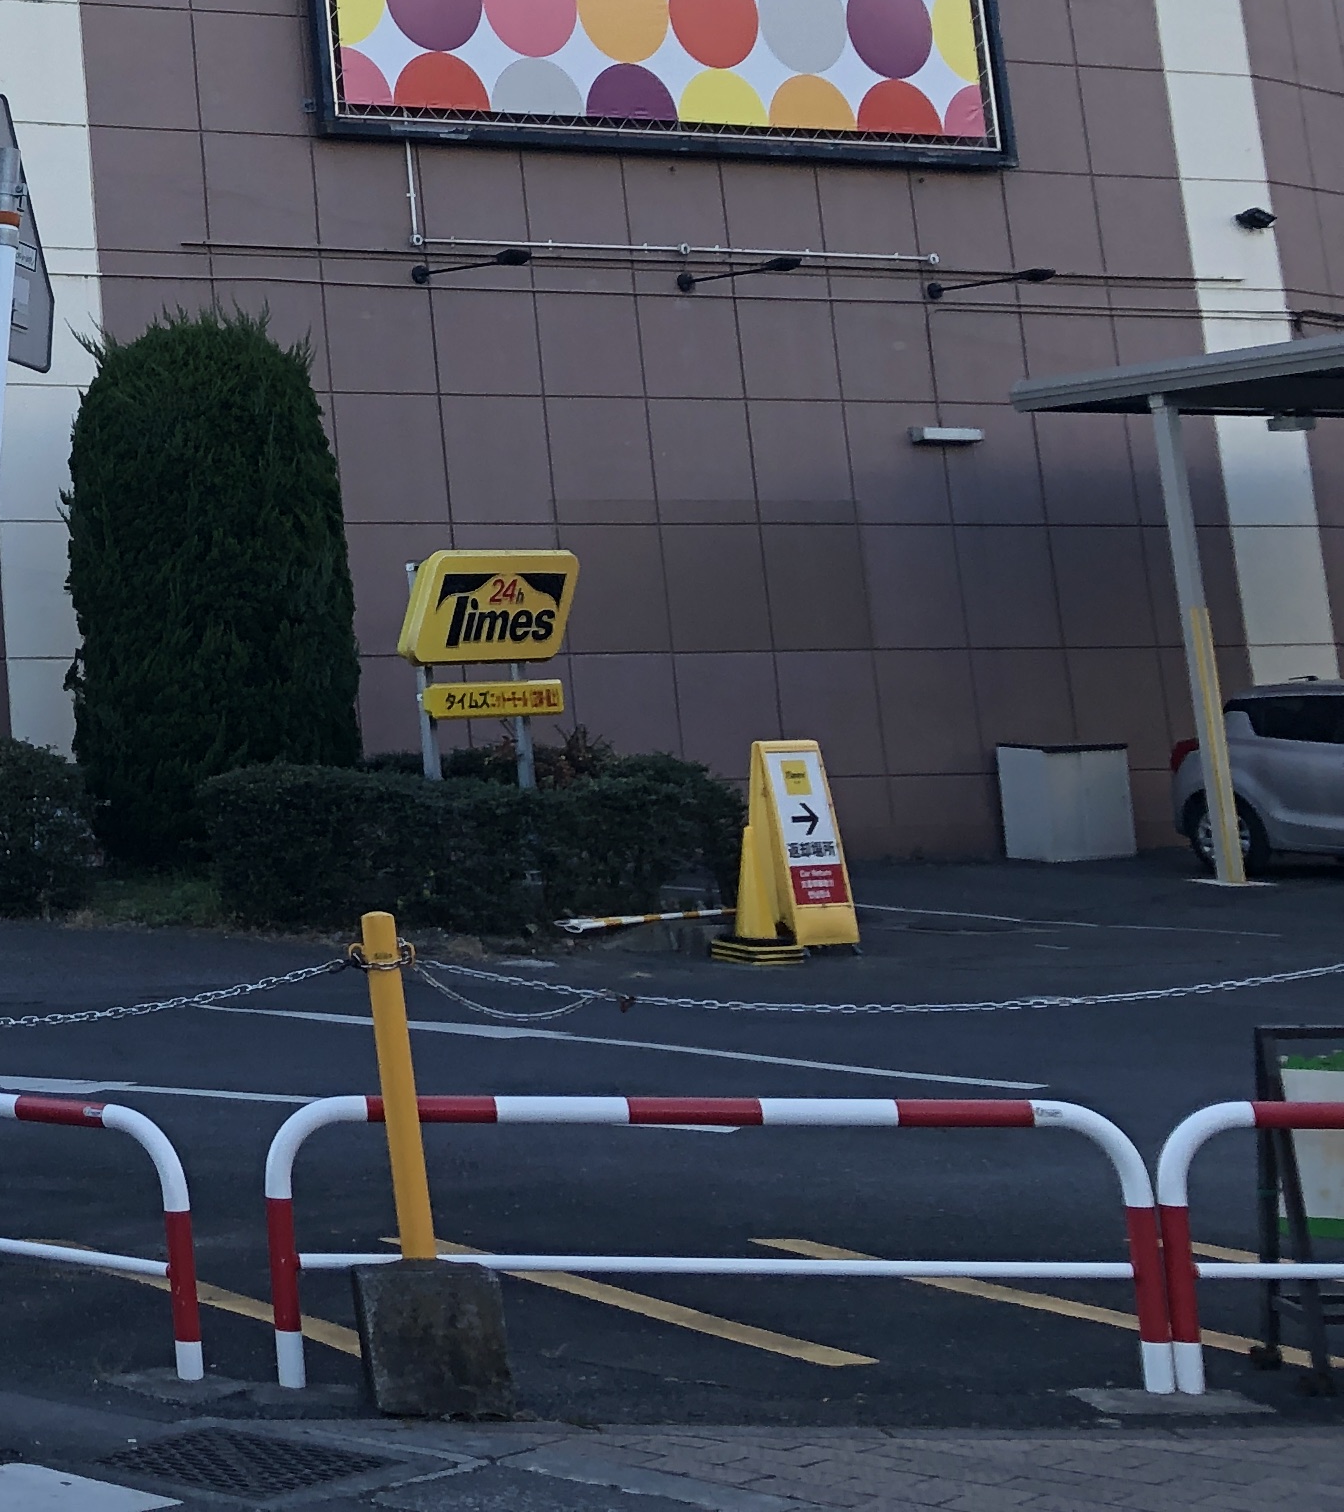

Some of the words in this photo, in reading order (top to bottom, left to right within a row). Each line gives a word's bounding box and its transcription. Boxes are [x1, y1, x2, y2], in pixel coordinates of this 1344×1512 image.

[489, 578, 525, 605] 24h
[446, 594, 556, 648] Times
[786, 841, 836, 858] 返却場所
